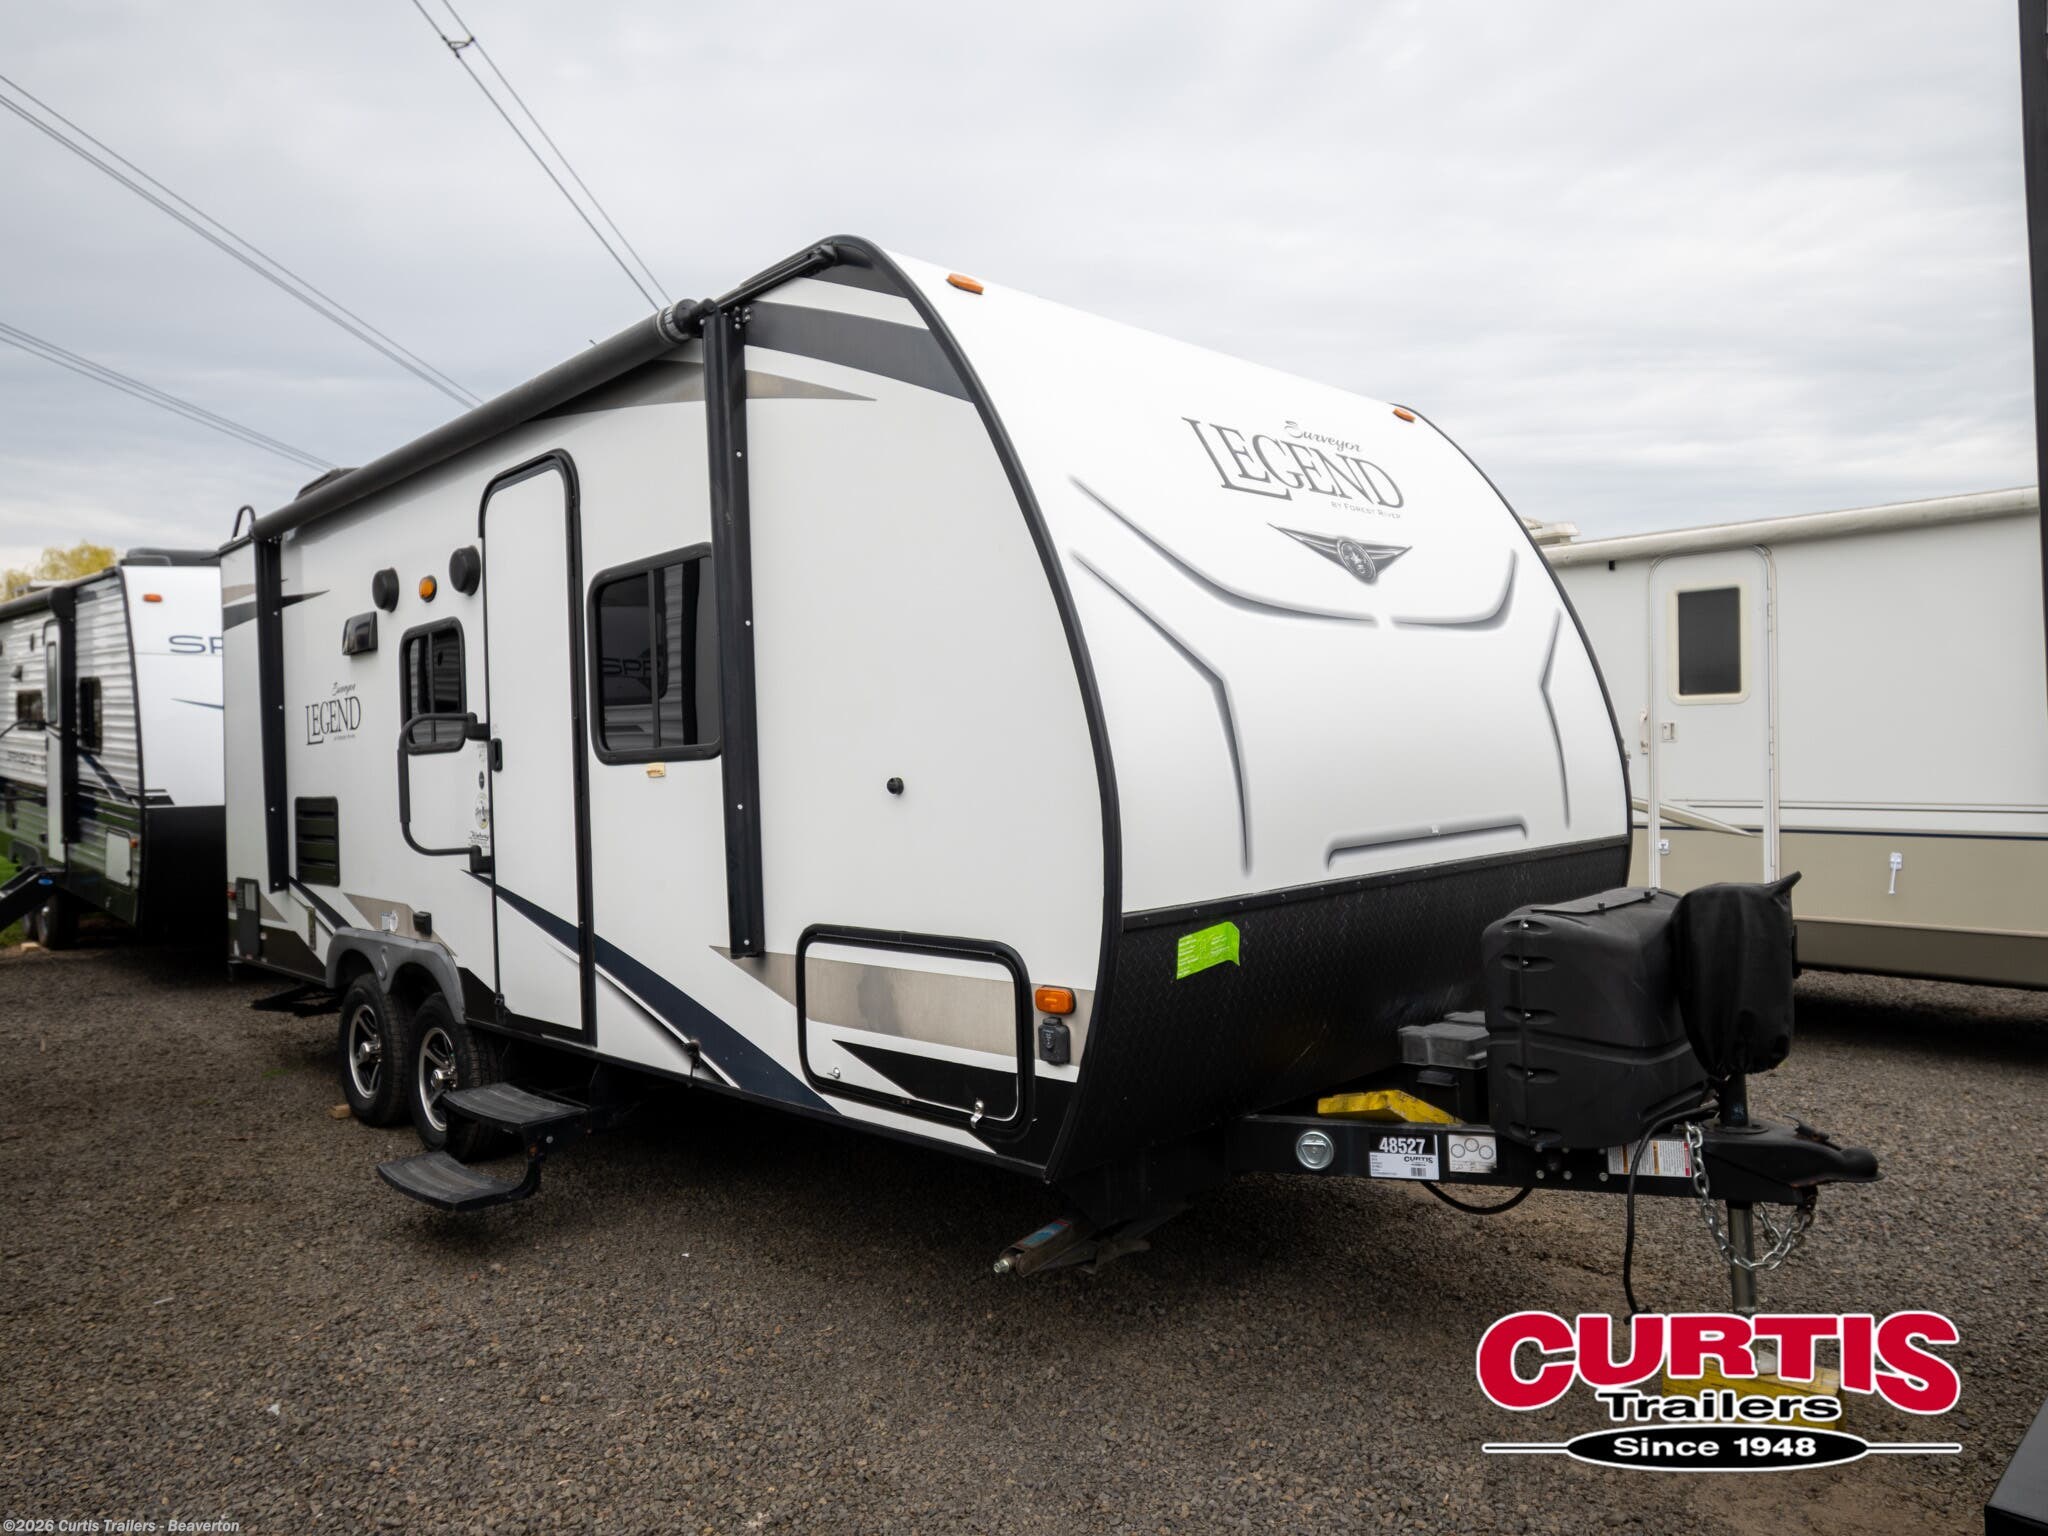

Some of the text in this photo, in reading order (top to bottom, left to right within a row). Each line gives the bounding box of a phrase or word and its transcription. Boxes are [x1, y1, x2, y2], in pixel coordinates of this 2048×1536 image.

[1284, 420, 1361, 452] Surveyor
[1181, 416, 1404, 508] LEGEND
[305, 696, 361, 746] LEGEND
[1379, 1136, 1426, 1155] 48527
[1404, 1155, 1434, 1165] CURTIS
